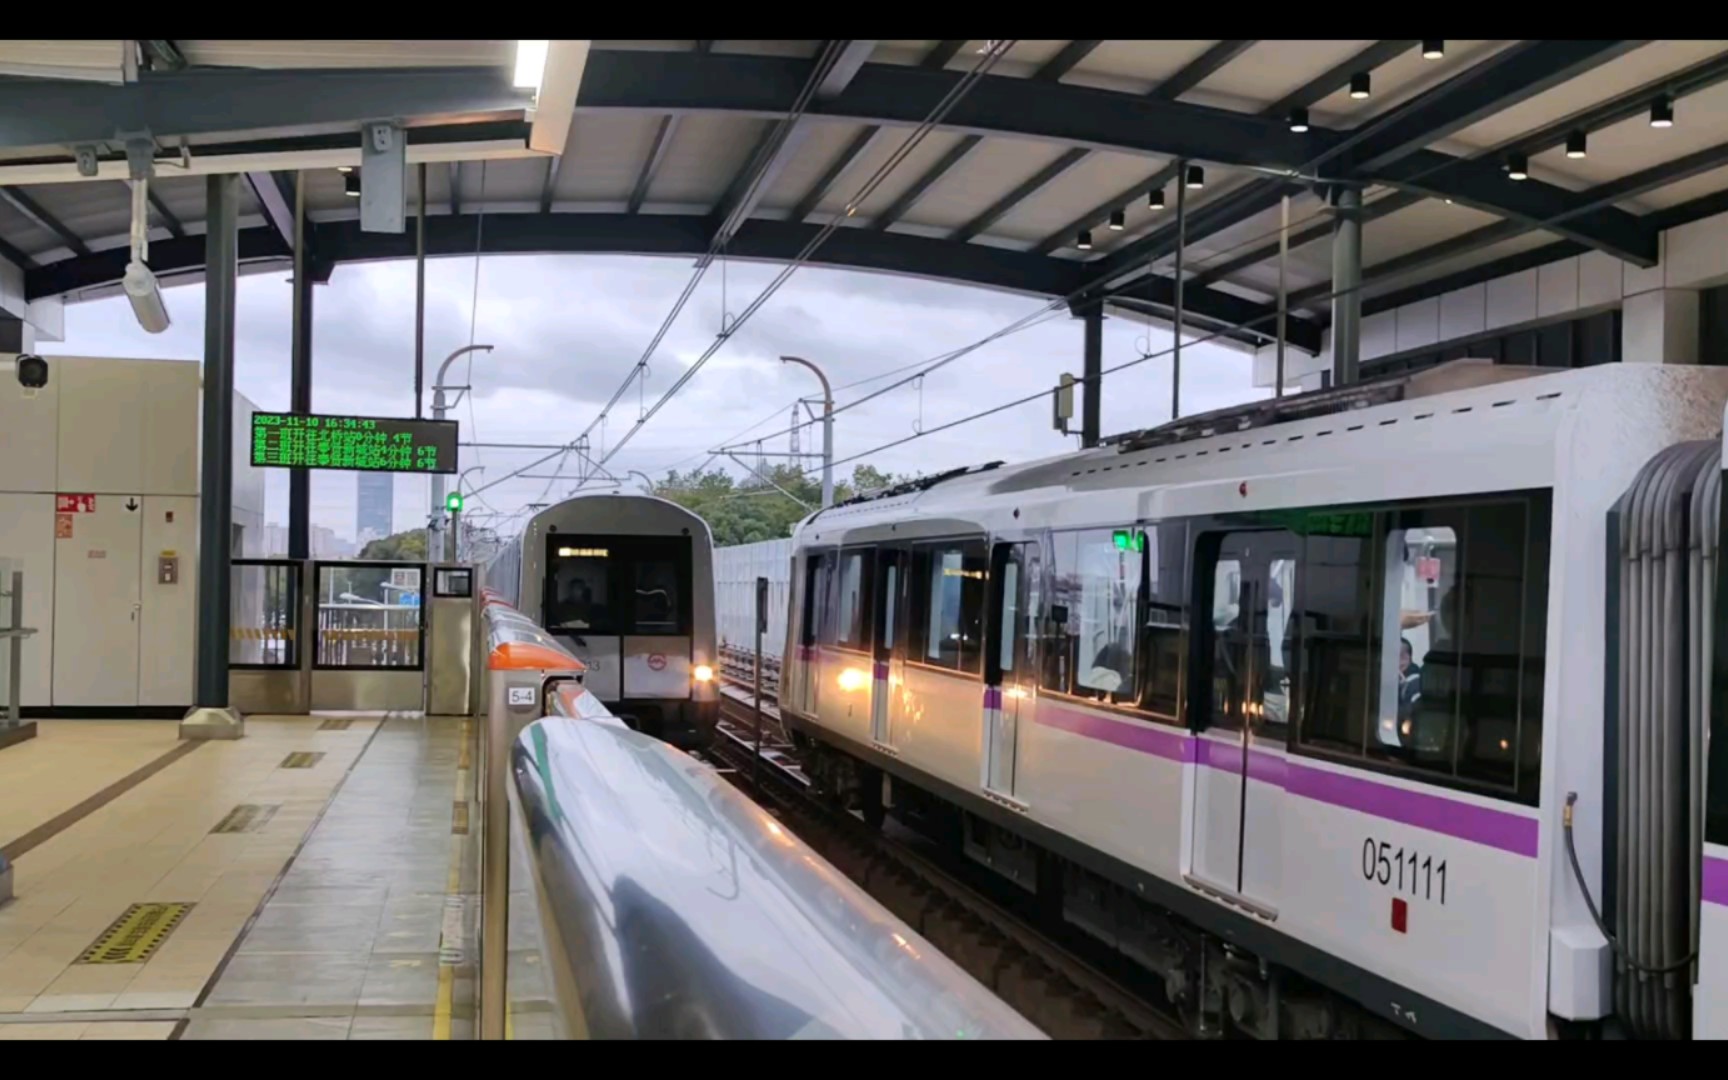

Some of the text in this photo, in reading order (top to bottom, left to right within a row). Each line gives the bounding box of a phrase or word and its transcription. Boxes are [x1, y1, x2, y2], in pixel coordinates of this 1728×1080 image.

[254, 415, 376, 429] 2023-11-10 16:34:43
[512, 690, 532, 702] 5-4
[1363, 837, 1446, 905] 051111
